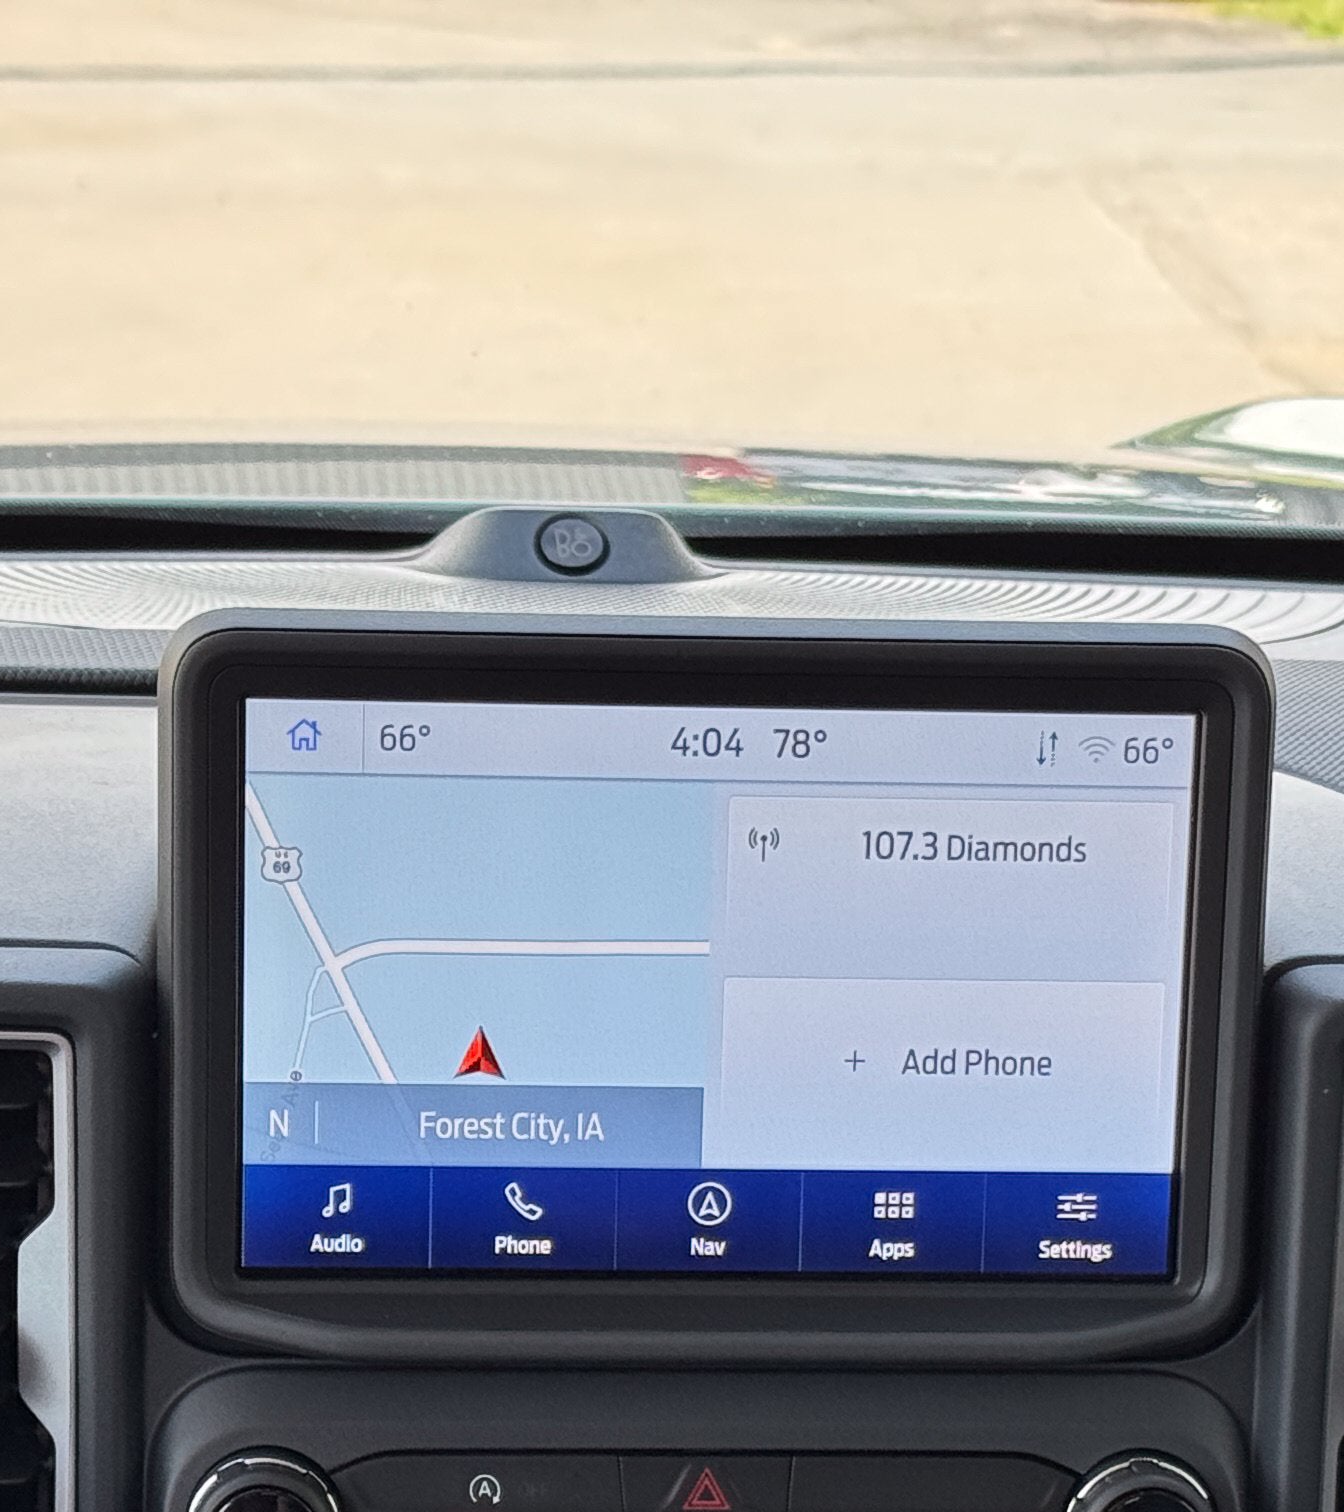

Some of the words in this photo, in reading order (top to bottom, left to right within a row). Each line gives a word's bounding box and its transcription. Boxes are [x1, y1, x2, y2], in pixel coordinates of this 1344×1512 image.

[379, 724, 431, 752] 66°
[670, 728, 744, 757] 4:04
[772, 729, 827, 758] 78°
[1123, 738, 1174, 765] 66°
[862, 832, 938, 861] 107.3
[947, 837, 1087, 863] Diamonds
[901, 1049, 956, 1075] Add
[964, 1050, 1052, 1076] Phone
[269, 1108, 288, 1137] N
[419, 1112, 505, 1139] Forest
[511, 1113, 568, 1144] City,
[575, 1114, 604, 1141] IA
[310, 1234, 363, 1254] Audio
[494, 1236, 551, 1256] Phone
[690, 1237, 727, 1257] Nav
[869, 1239, 914, 1261] Apps
[1038, 1239, 1112, 1263] Settings
